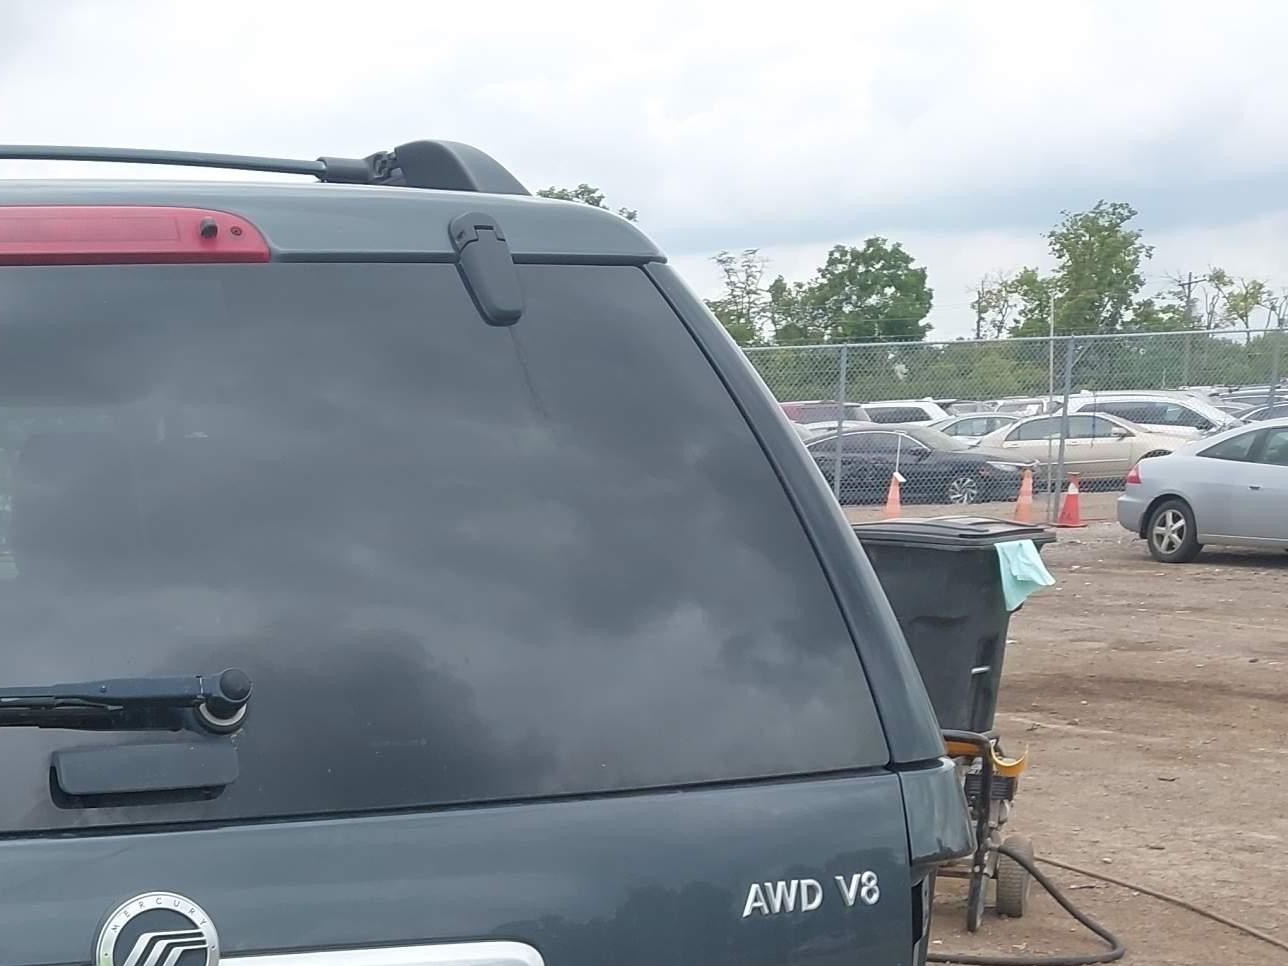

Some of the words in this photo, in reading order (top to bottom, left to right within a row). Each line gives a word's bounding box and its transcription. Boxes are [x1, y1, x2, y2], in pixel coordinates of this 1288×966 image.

[110, 896, 208, 933] MERCURY
[741, 878, 824, 919] AWD
[834, 870, 881, 907] V8
